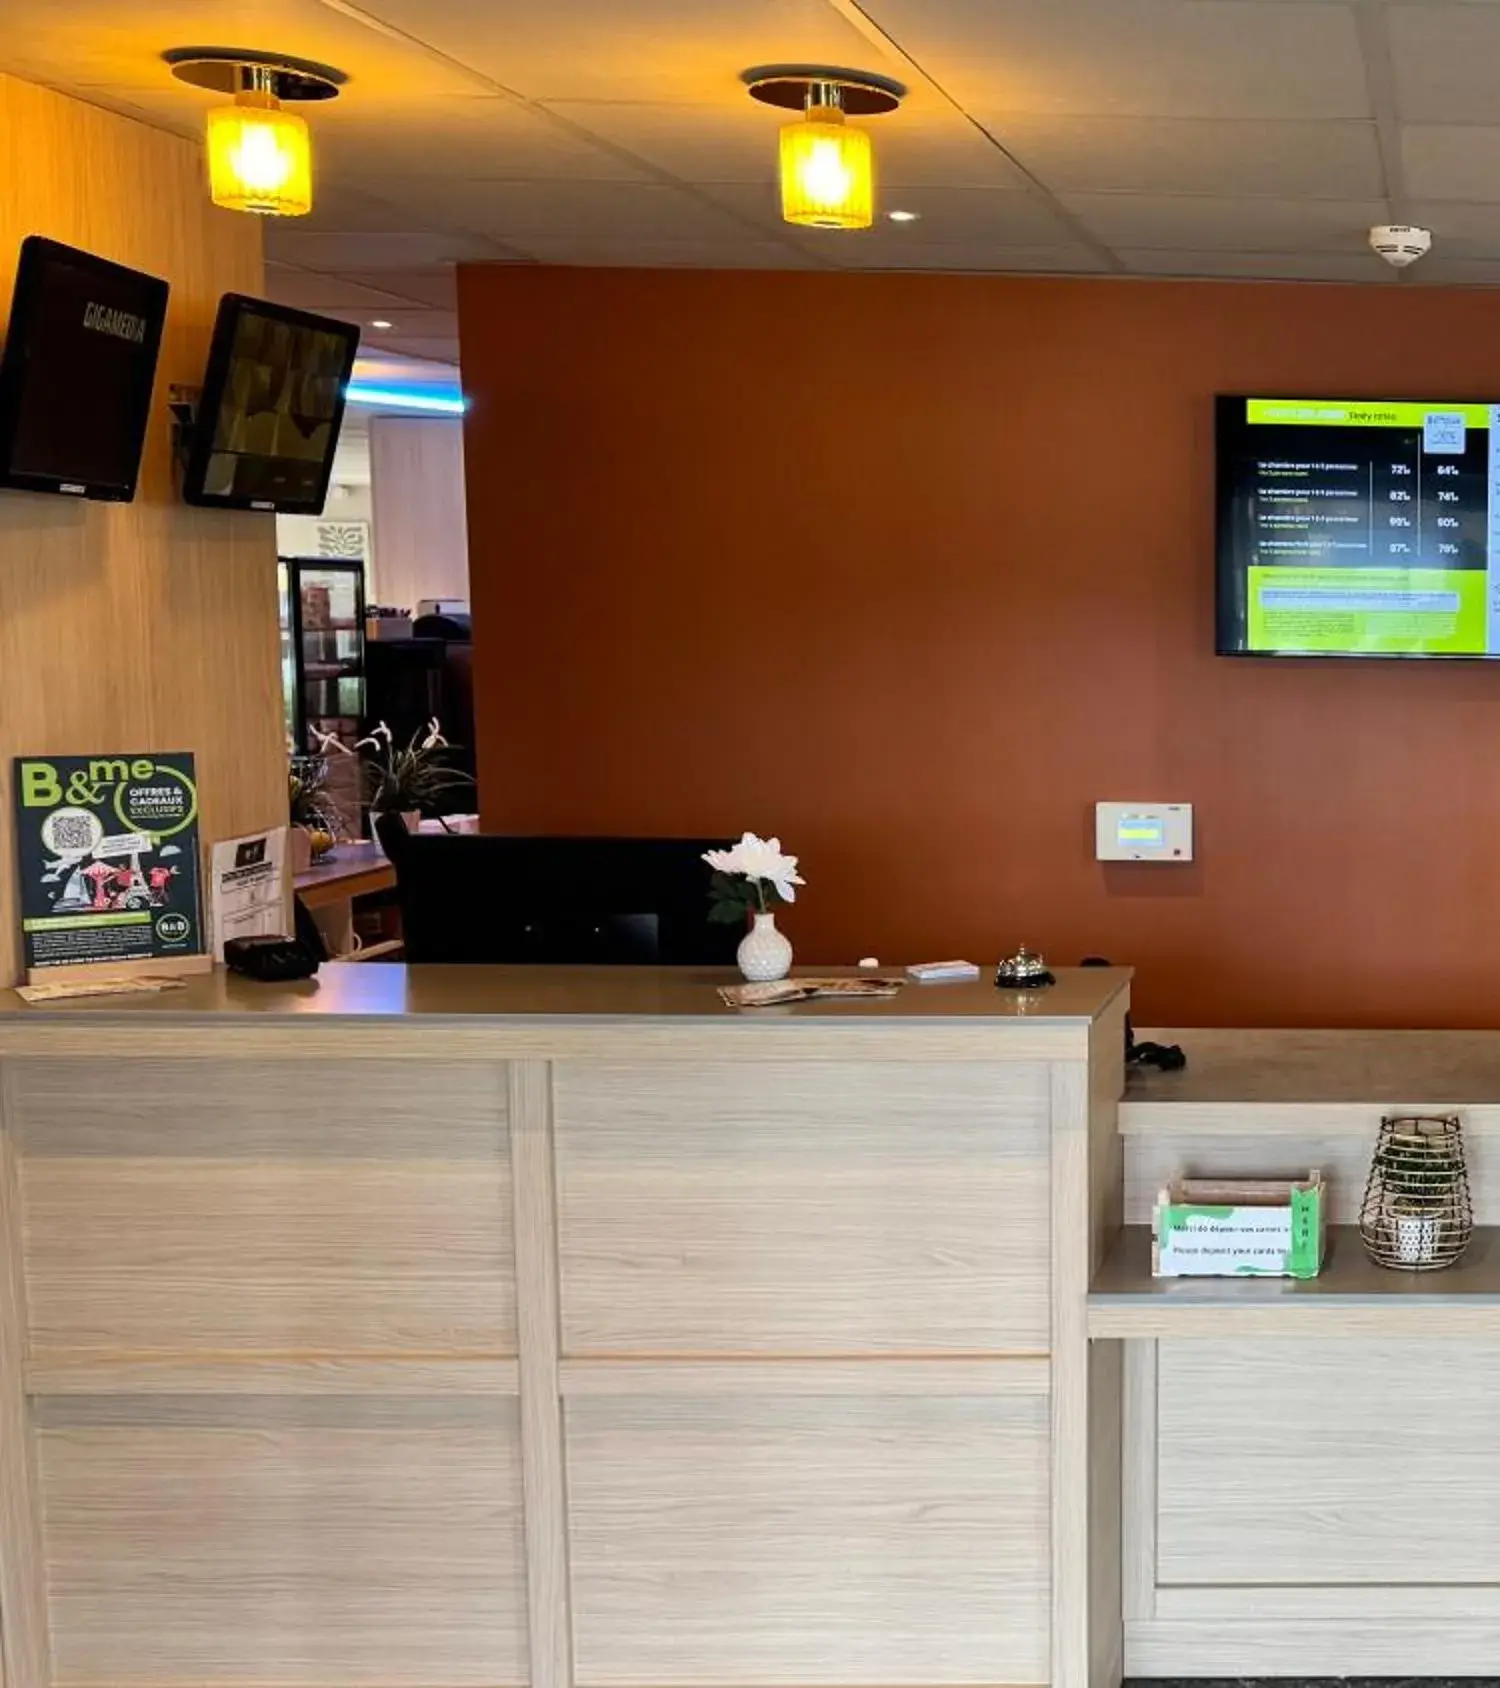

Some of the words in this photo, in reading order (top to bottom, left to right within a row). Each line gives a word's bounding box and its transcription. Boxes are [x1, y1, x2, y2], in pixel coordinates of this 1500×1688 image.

[83, 301, 146, 344] GIGAMEDIA
[129, 787, 171, 797] OFFRES
[173, 786, 183, 795] &
[129, 796, 184, 805] CADEAUX
[161, 921, 185, 931] B&B
[1173, 1247, 1199, 1255] Please
[1232, 1248, 1252, 1257] your
[1253, 1247, 1276, 1256] cards
